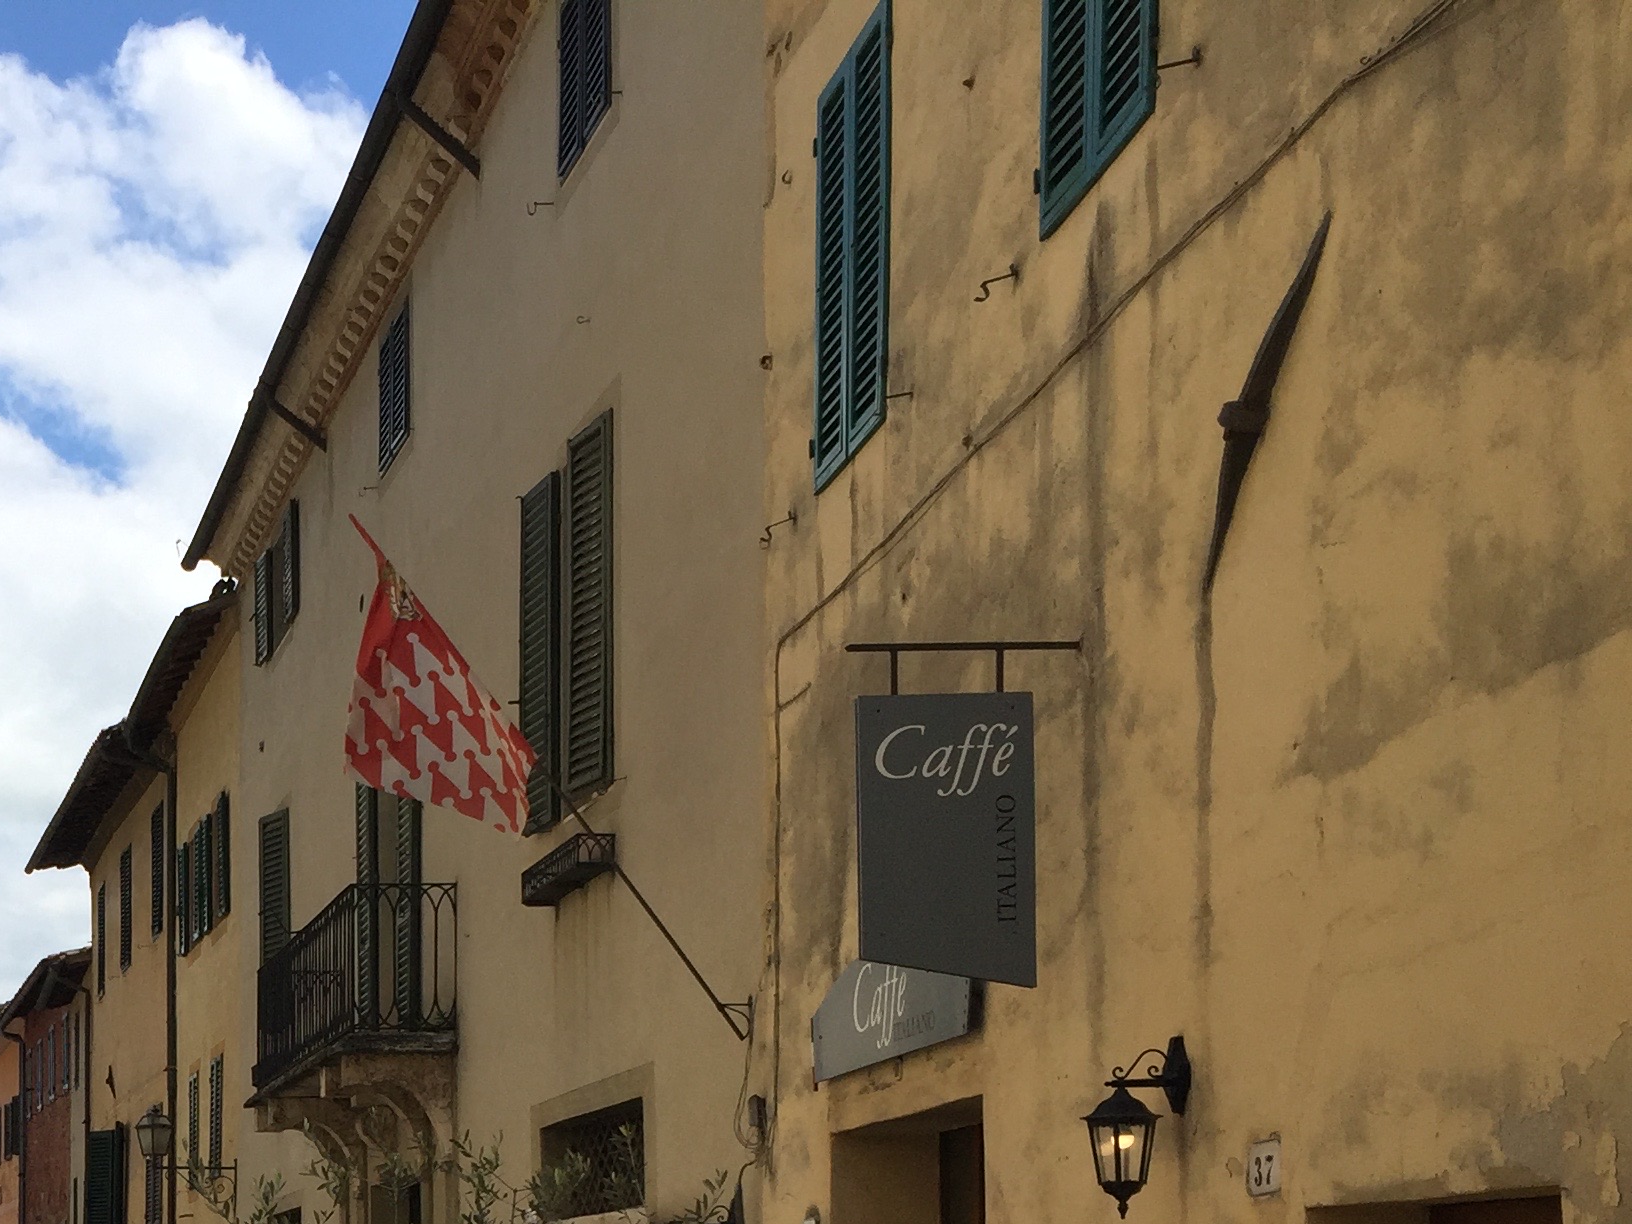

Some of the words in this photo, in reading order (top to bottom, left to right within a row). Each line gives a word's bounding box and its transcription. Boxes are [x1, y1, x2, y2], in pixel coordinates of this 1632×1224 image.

[875, 722, 1019, 797] Caffé
[996, 794, 1017, 923] ITALIANO
[1254, 1154, 1274, 1187] 37
